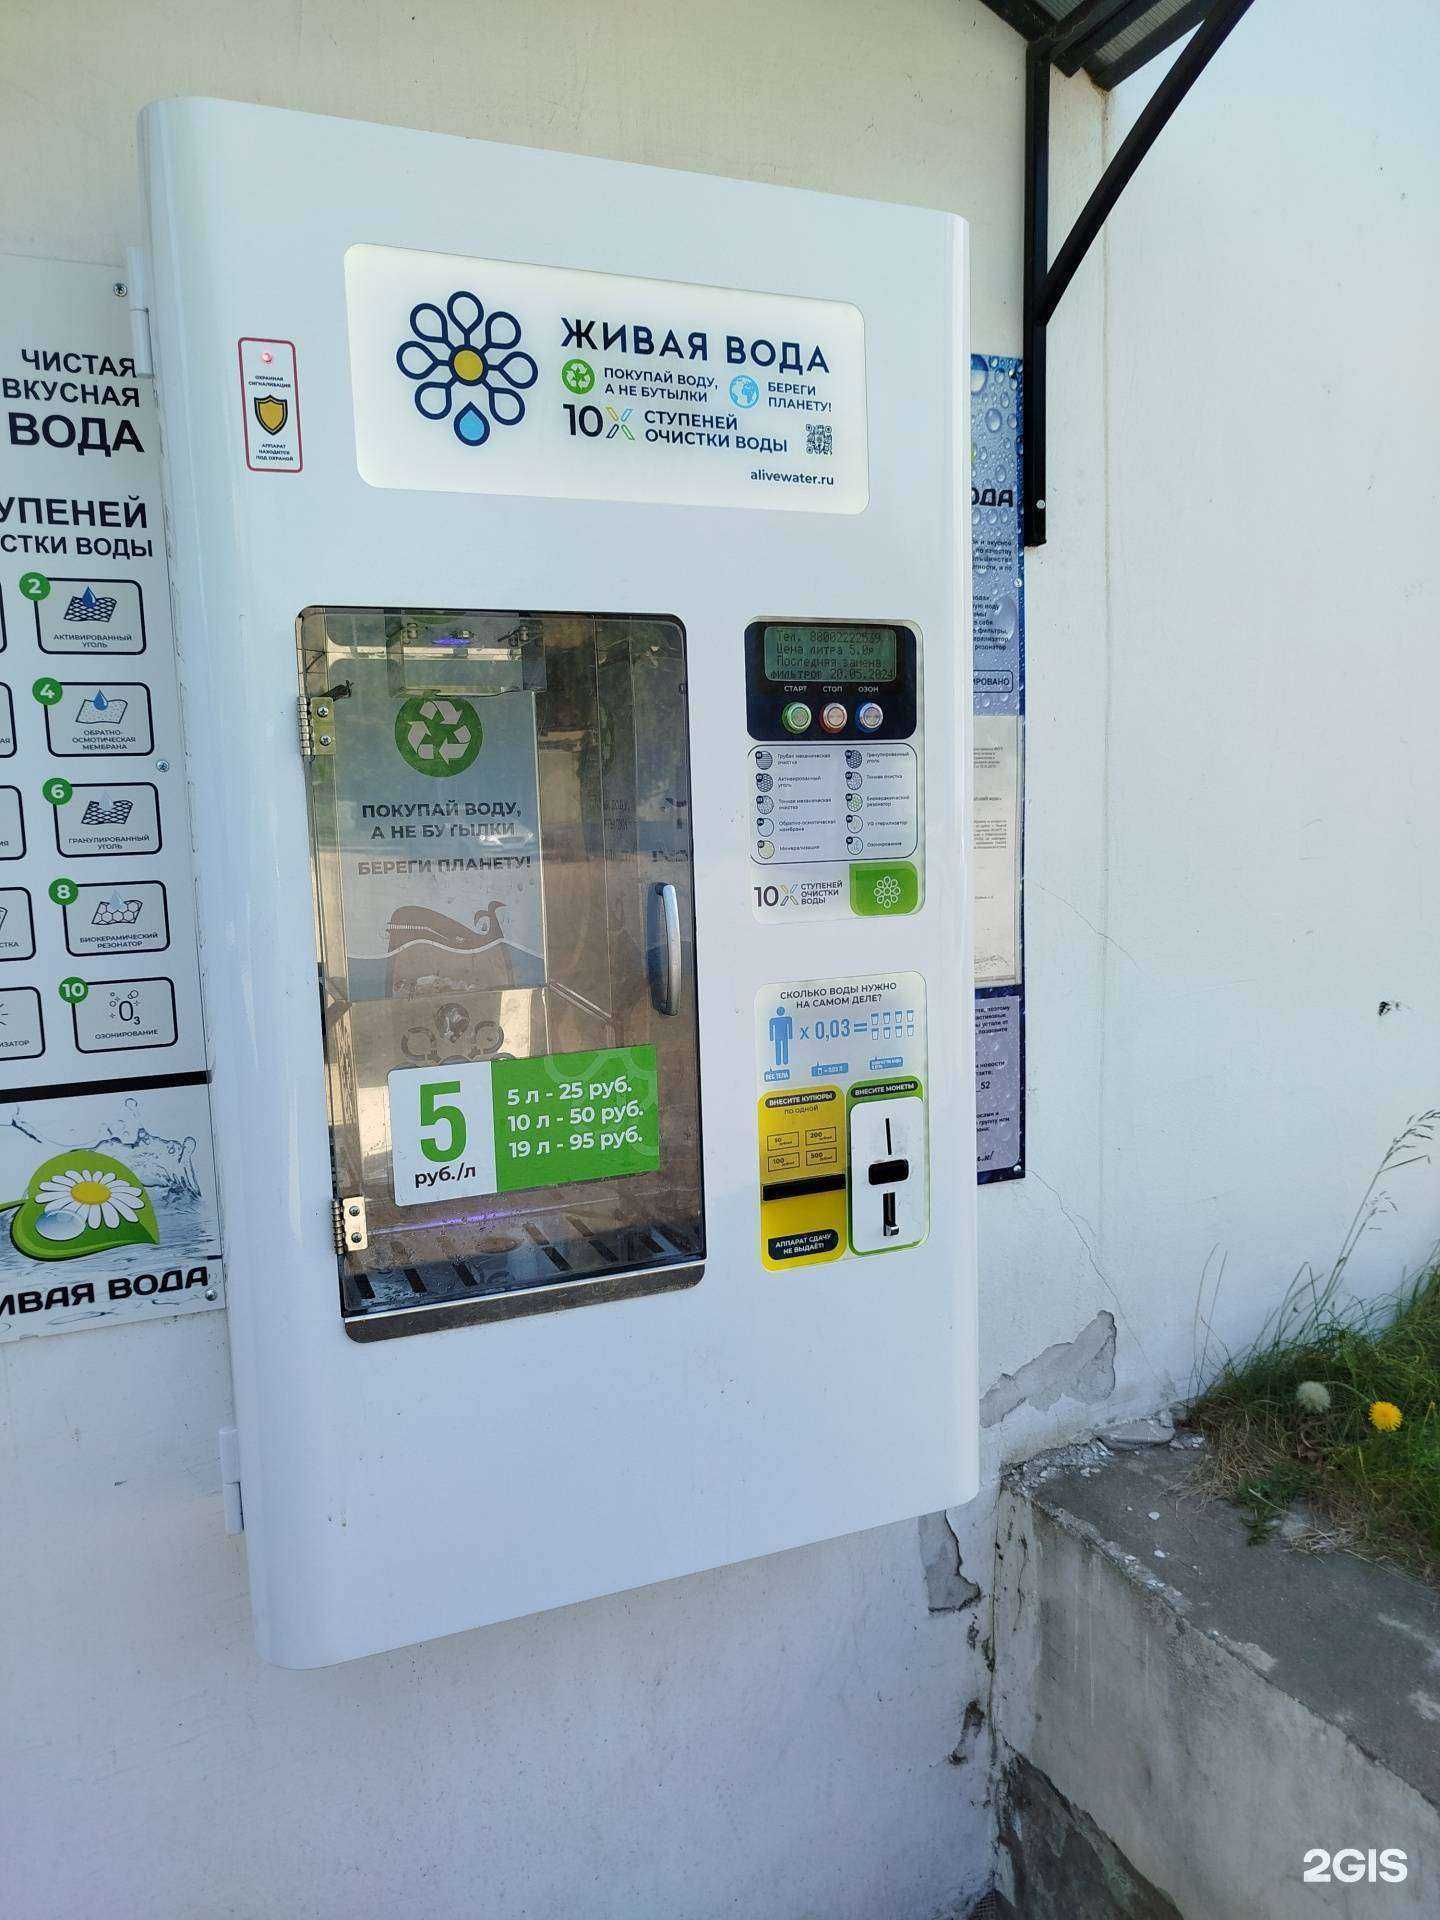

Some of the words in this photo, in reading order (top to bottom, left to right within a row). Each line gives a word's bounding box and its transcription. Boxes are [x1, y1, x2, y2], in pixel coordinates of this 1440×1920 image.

[561, 317, 708, 361] ЖИВАЯ
[726, 335, 830, 376] ВОДА
[21, 349, 136, 378] ЧИСТАЯ
[604, 367, 673, 384] ПОКУПАЙ
[678, 374, 718, 390] ВОДУ,
[3, 378, 140, 407] ВКУСНАЯ
[604, 384, 614, 395] А
[619, 385, 637, 397] НЕ
[641, 387, 707, 402] БУТЫЛКИ
[768, 381, 816, 396] БЕРЕГИ
[768, 397, 832, 412] ПЛАНЕТУ!
[644, 410, 738, 430] СТУПЕНЕЙ
[8, 412, 145, 457] ВОДА
[645, 429, 730, 448] ОЧИСТКИ
[735, 435, 787, 453] ВОДЫ
[750, 469, 834, 486] alivewater.ru
[76, 537, 153, 560] ВОДЫ
[28, 579, 42, 594] 2
[973, 678, 1010, 686] РОВАНО
[40, 684, 55, 699] 4
[51, 784, 65, 798] 6
[361, 799, 459, 819] ПОКУПАЙ
[464, 801, 522, 818] ВОДУ,
[371, 826, 385, 839] А
[391, 826, 417, 839] НЕ
[358, 858, 432, 876] БЕРЕГИ
[438, 855, 531, 873] ПЛАНЕТУ!
[57, 885, 71, 899] 8
[801, 880, 843, 890] СТУПЕНЕЙ
[801, 889, 839, 897] ОЧИСТКИ
[801, 897, 826, 905] ВОДЫ
[62, 982, 85, 998] 10
[780, 989, 827, 1000] СКОЛЬКО
[830, 986, 859, 996] ВОДЫ
[862, 982, 897, 992] НУЖНО
[796, 1000, 810, 1009] НА
[813, 998, 849, 1007] САМОМ
[852, 994, 882, 1005] ДЕЛЕ?
[95, 1029, 158, 1039] ОЗОНИРОВАНИЕ
[815, 1019, 850, 1041] 0,03
[507, 1089, 520, 1105] 5
[525, 1090, 540, 1104] л
[559, 1082, 584, 1100] 25
[589, 1075, 632, 1098] руб.
[855, 1087, 885, 1096] ВНЕСИТЕ
[886, 1083, 915, 1092] МОНЕТЫ
[769, 1096, 800, 1106] ВНЕСИТЕ
[801, 1092, 834, 1102] КУПЮРЫ
[420, 1080, 467, 1162] 5
[507, 1114, 530, 1132] 10
[536, 1115, 550, 1129] л
[570, 1106, 595, 1124] 50
[600, 1100, 644, 1124] руб.
[508, 1141, 530, 1158] 19
[536, 1141, 550, 1155] л
[570, 1132, 595, 1150] 95
[600, 1126, 643, 1150] руб.
[414, 1163, 476, 1188] руб./л
[775, 1237, 808, 1248] АППАРАТ
[808, 1233, 831, 1244] СДАЧУ
[108, 1266, 208, 1300] ВОДА
